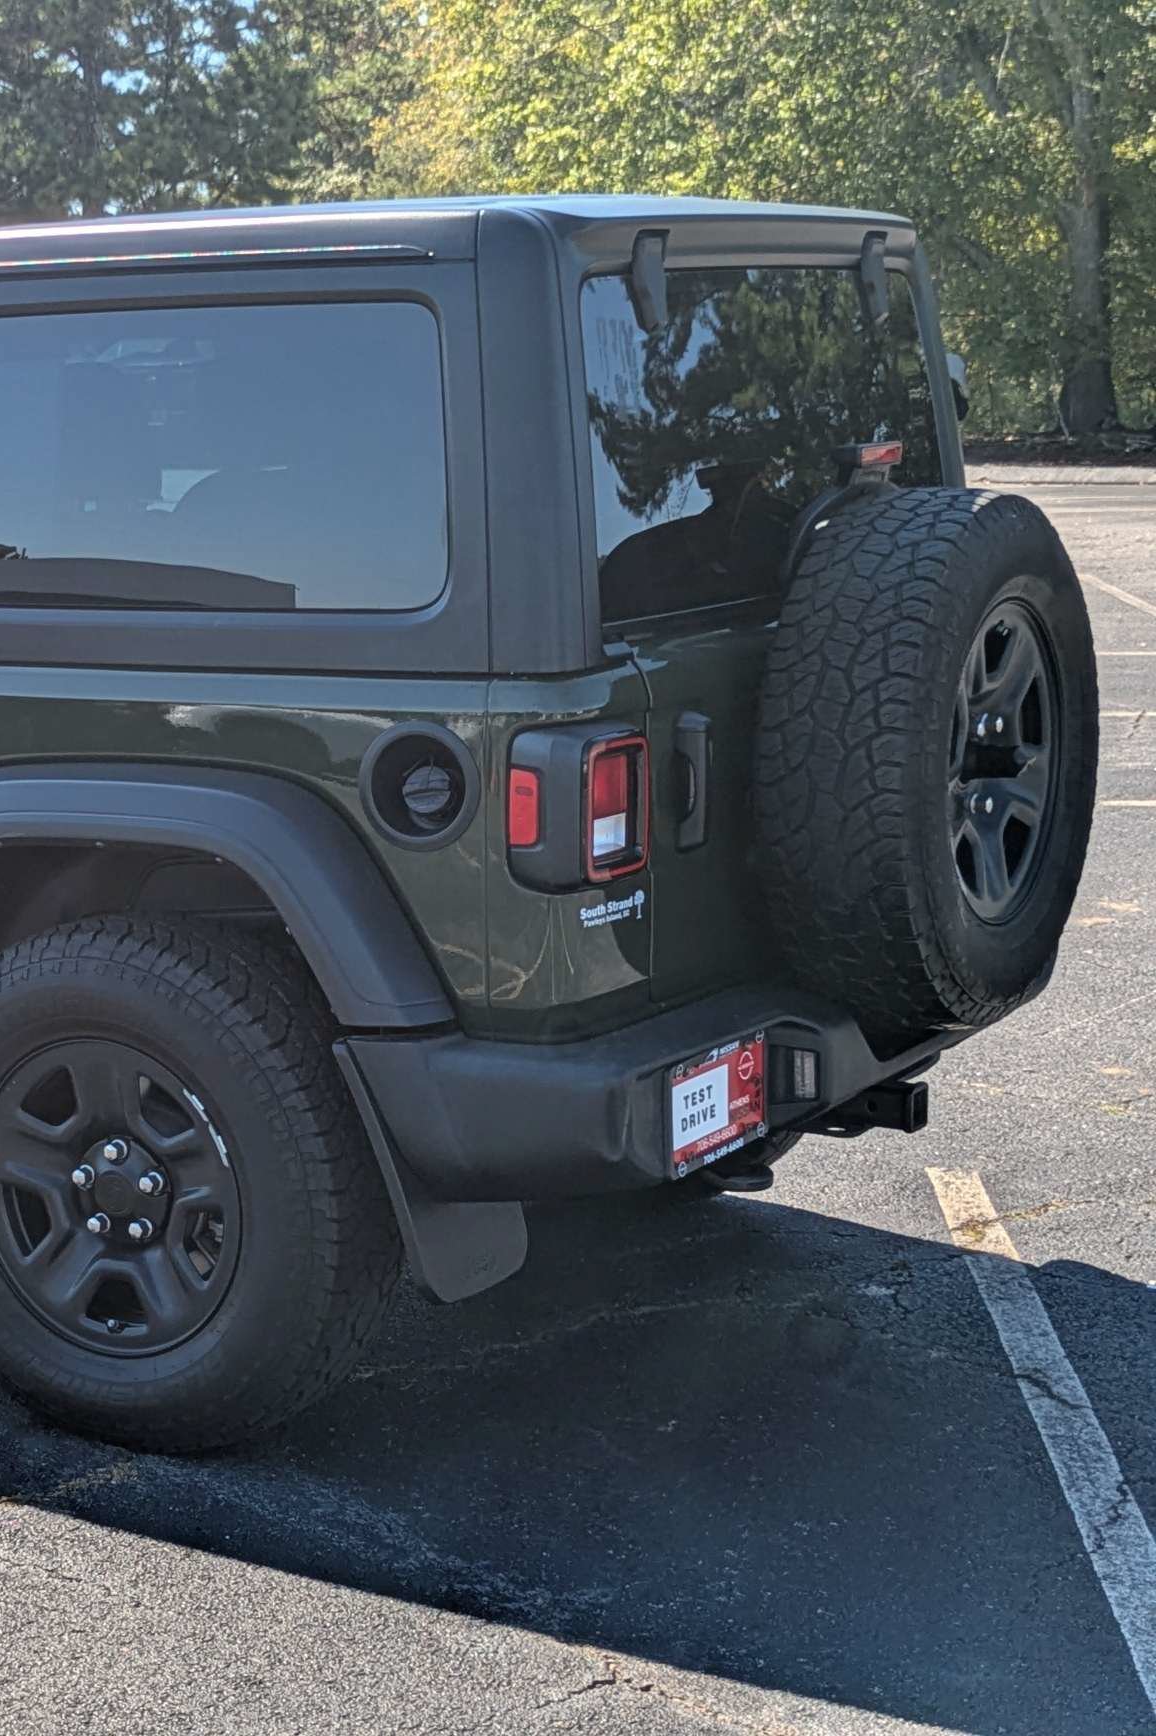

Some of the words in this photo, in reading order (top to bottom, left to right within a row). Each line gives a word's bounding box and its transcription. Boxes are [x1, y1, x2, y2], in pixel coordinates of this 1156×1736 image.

[580, 903, 606, 920] South
[606, 895, 634, 913] Strand
[682, 1084, 714, 1110] TEST
[680, 1103, 717, 1133] DRIVE
